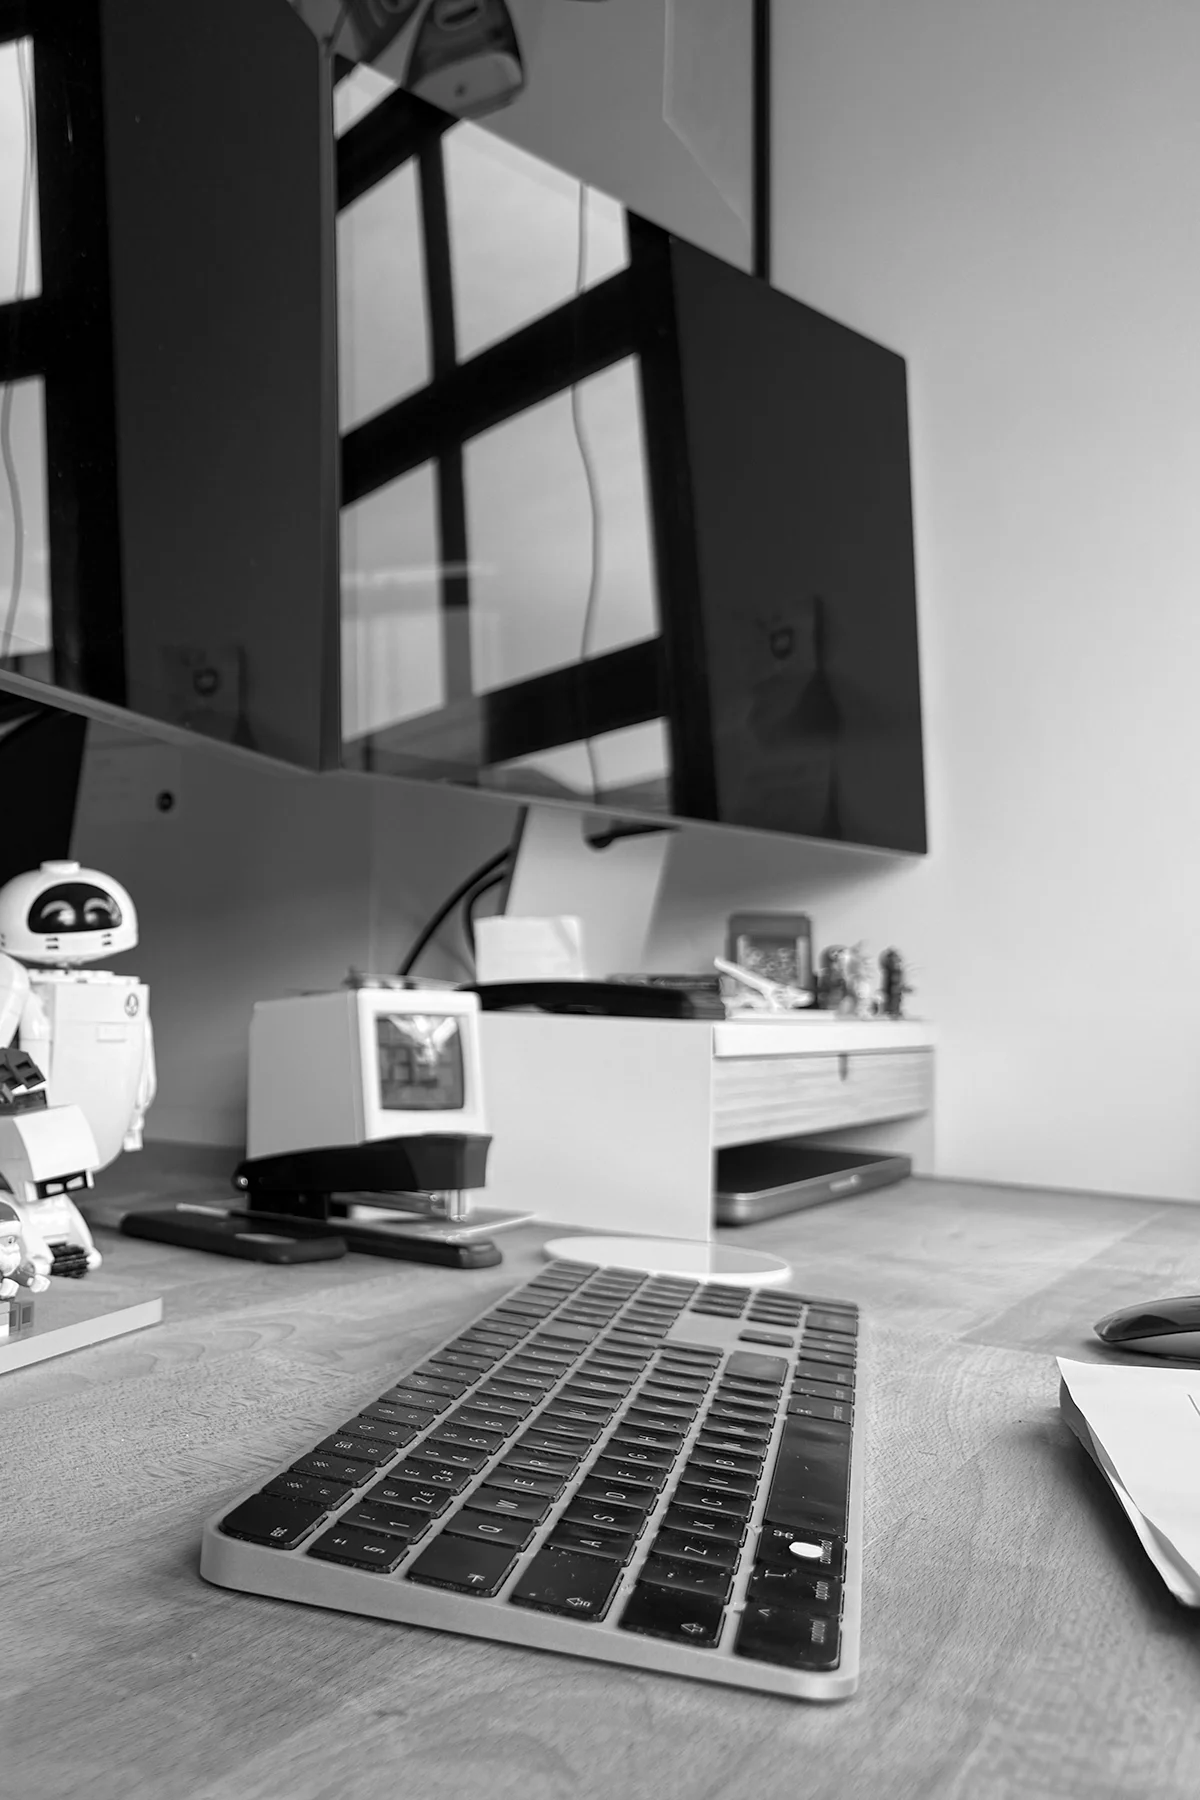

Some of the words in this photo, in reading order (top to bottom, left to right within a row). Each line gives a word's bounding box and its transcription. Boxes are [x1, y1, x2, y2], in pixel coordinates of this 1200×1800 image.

[628, 1452, 647, 1460] G
[617, 1470, 637, 1479] F
[514, 1478, 535, 1487] E
[605, 1491, 626, 1499] D
[495, 1499, 519, 1510] W
[701, 1498, 722, 1506] C
[593, 1514, 615, 1523] S
[478, 1524, 503, 1534] Q
[692, 1520, 715, 1530] X
[579, 1539, 602, 1548] A
[684, 1546, 707, 1556] Z
